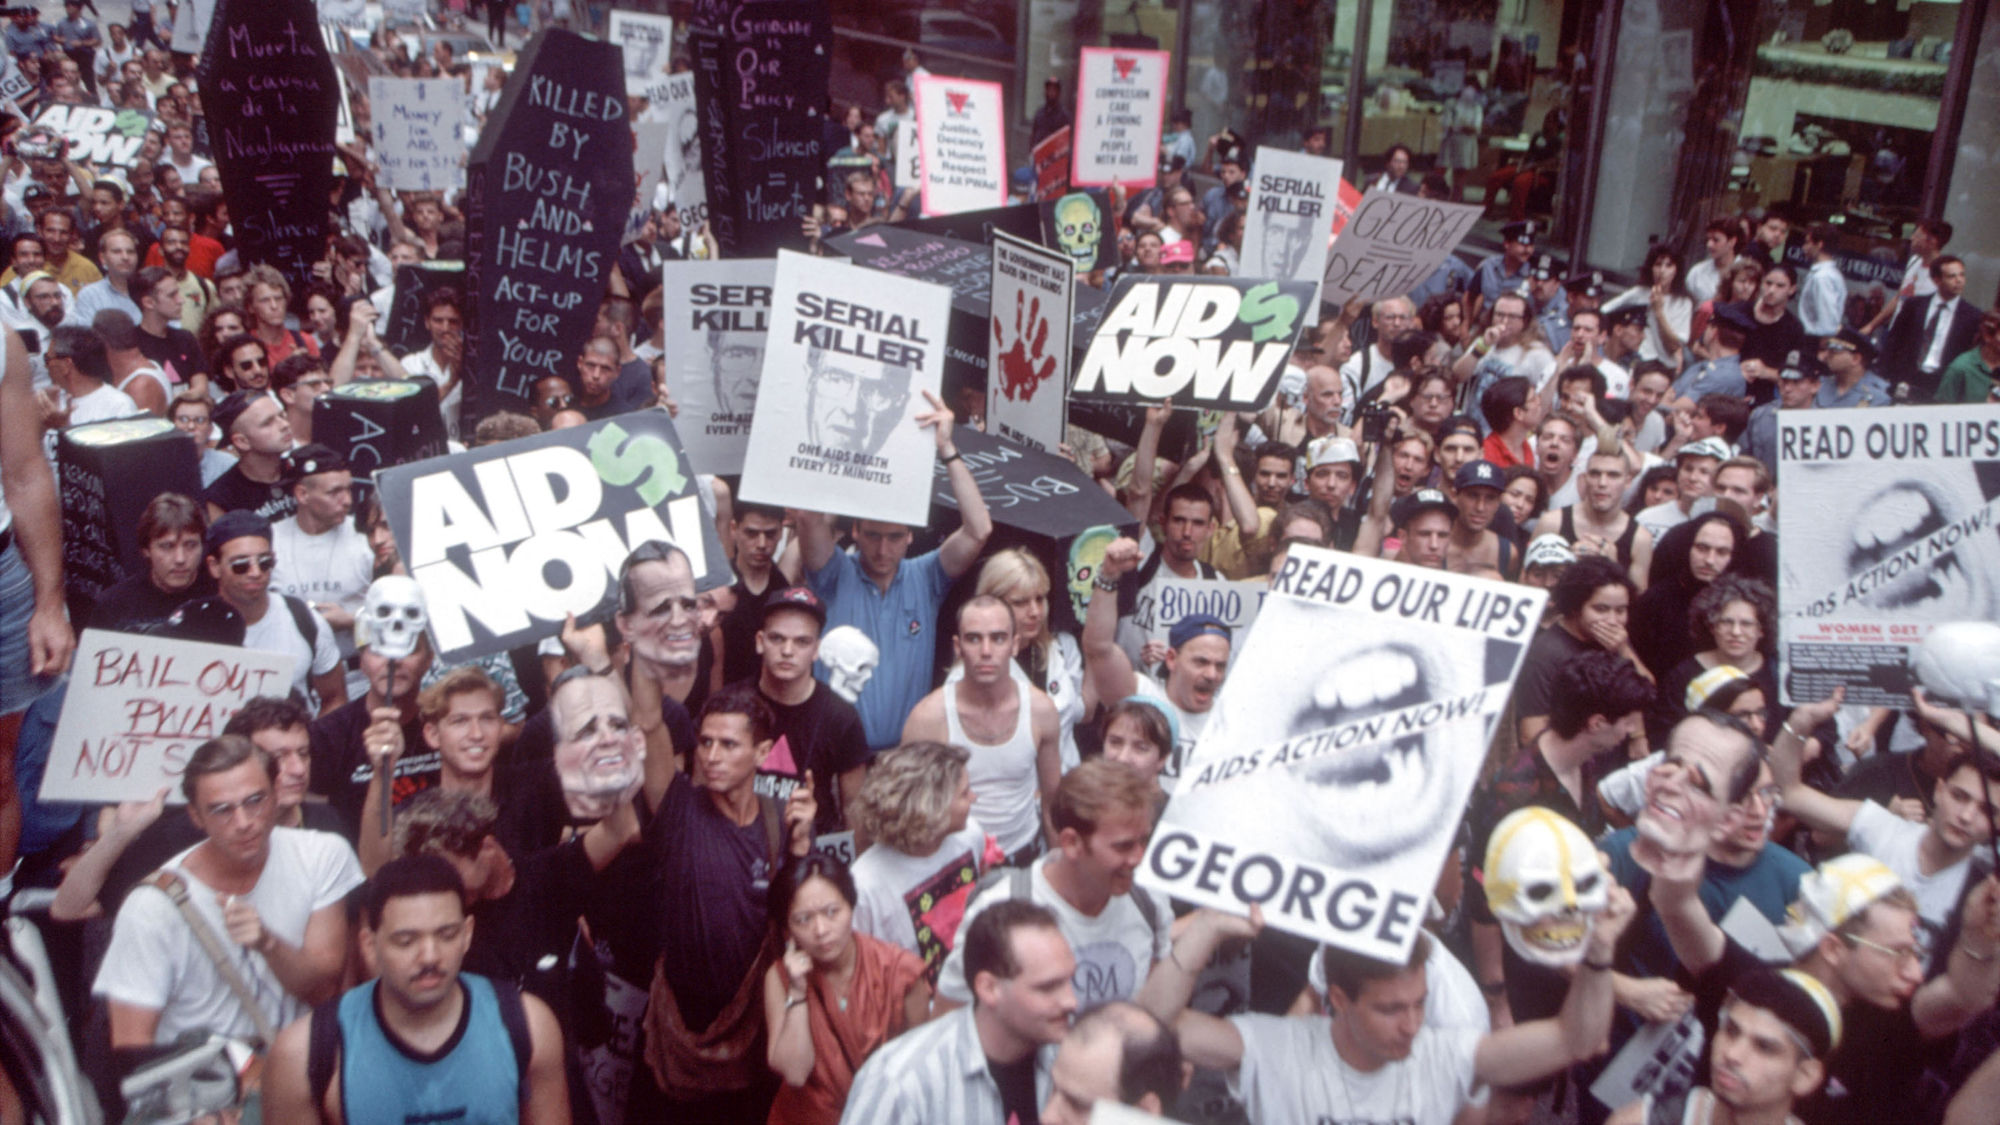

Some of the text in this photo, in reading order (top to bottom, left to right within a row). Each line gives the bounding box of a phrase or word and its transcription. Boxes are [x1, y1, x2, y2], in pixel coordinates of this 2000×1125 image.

[229, 20, 317, 58] Muerta
[736, 48, 781, 77] OUR
[242, 95, 263, 117] de
[529, 74, 622, 121] KILLED
[1109, 102, 1131, 113] CARE
[1106, 114, 1142, 127] FUNDING
[1110, 127, 1126, 139] FOR
[550, 122, 590, 161] BY
[936, 134, 985, 149] Decency
[948, 150, 986, 162] Human
[1100, 141, 1133, 152] PEOPLE
[930, 173, 945, 183] for
[942, 161, 987, 175] Respect
[1095, 154, 1139, 166] WITH AIDS
[504, 152, 591, 211] BUSH
[1259, 174, 1325, 199] SERIAL
[530, 198, 582, 235] AND
[1256, 195, 1323, 219] KILLER
[1352, 197, 1473, 250] GEORGE
[1324, 252, 1432, 296] DEATH
[494, 275, 583, 310] ACT-UP
[514, 308, 560, 337] FOR
[795, 291, 929, 345] SERIAL
[499, 329, 563, 375] YOUR
[793, 320, 926, 372] KILLER
[1073, 335, 1290, 403] NOW
[797, 443, 889, 469] ONE AIDS DEATH
[1781, 418, 2000, 461] READ OUR LIPS
[789, 456, 893, 485] EVERY 12 MINUTES
[1843, 541, 1920, 602] ACTION
[1926, 506, 1992, 558] NOW!
[287, 581, 343, 594] QUEER
[413, 495, 708, 654] NOW
[1274, 556, 1363, 604] READ
[1372, 573, 1450, 624] OUR
[1455, 588, 1534, 638] LIPS
[1818, 623, 1919, 636] WOMEN GET
[93, 647, 279, 701] BAIL OUT
[72, 736, 153, 780] NOT
[1191, 748, 1264, 791] AIDS
[1268, 716, 1384, 768] ACTION
[1392, 690, 1487, 734] NOW!
[1149, 832, 1421, 946] GEORGE
